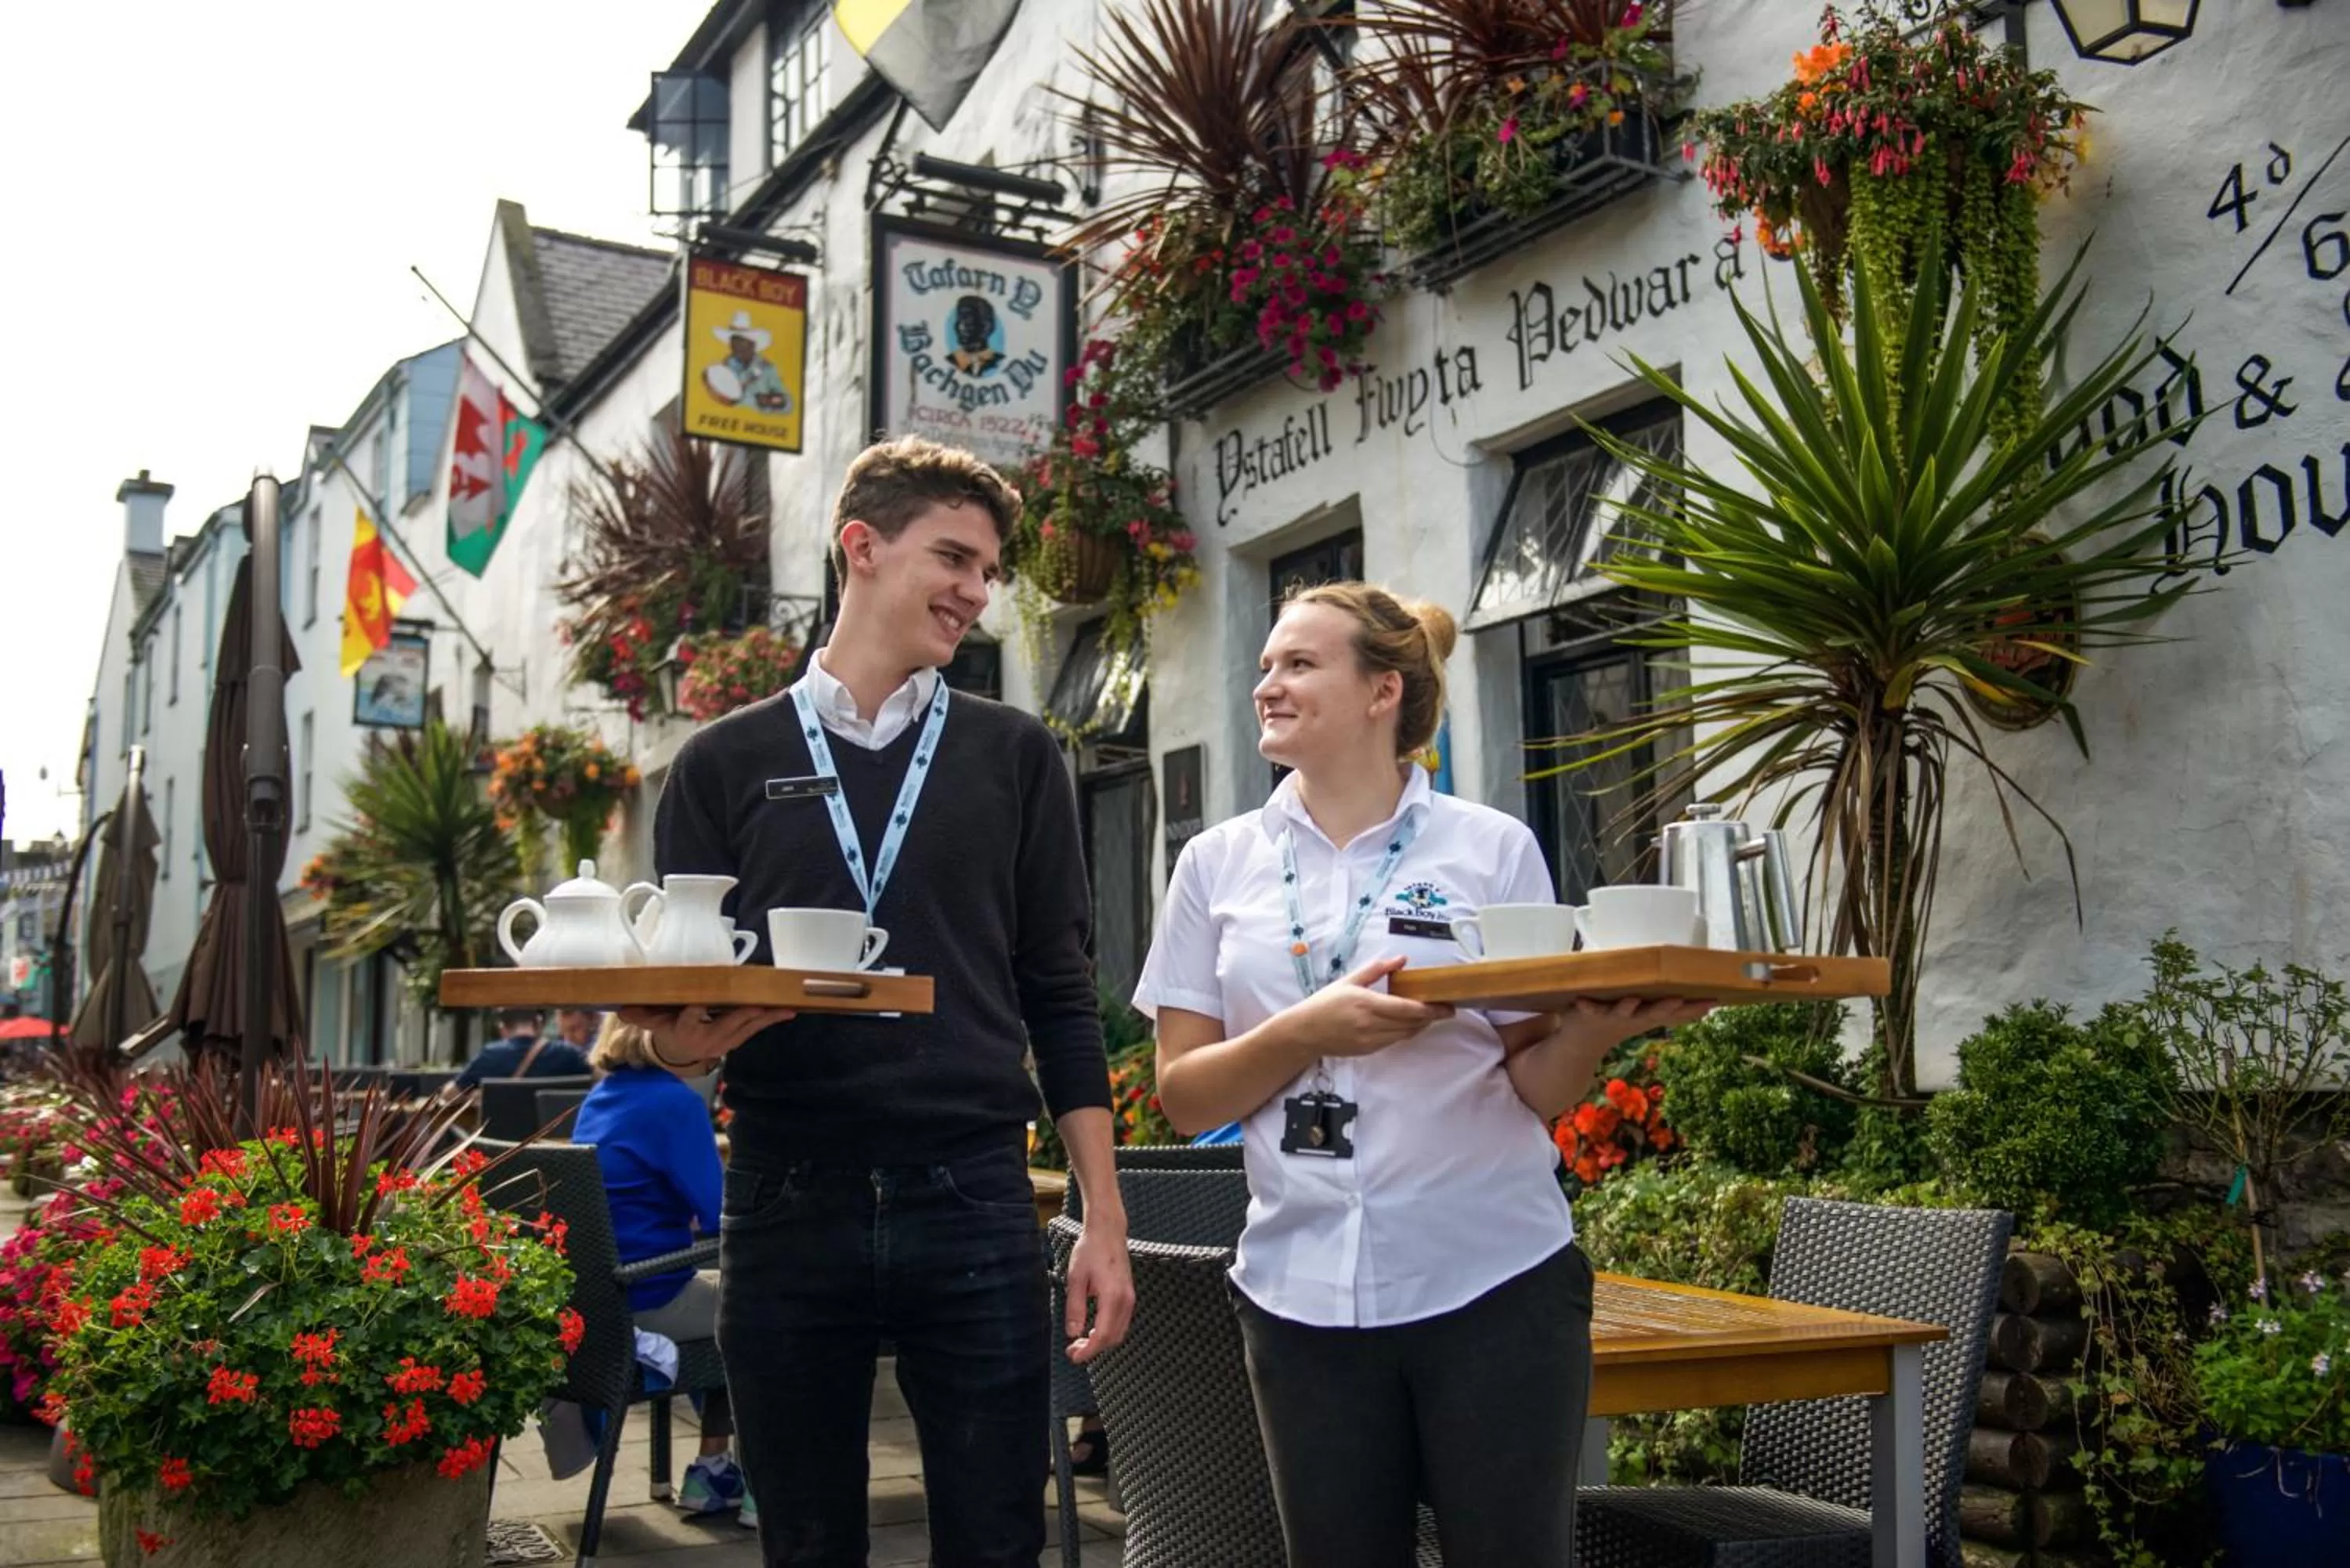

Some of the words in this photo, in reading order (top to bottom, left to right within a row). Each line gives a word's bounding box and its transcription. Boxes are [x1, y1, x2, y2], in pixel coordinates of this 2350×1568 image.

[695, 266, 755, 297] BLACK
[759, 278, 797, 305] BOY
[902, 257, 1006, 296] Tafarn
[896, 320, 1010, 414] Bachgen
[1002, 349, 1049, 399] Du
[2234, 353, 2300, 430] &
[697, 412, 739, 432] FREE
[744, 421, 787, 439] HOUSE
[914, 405, 972, 428] CIRCA
